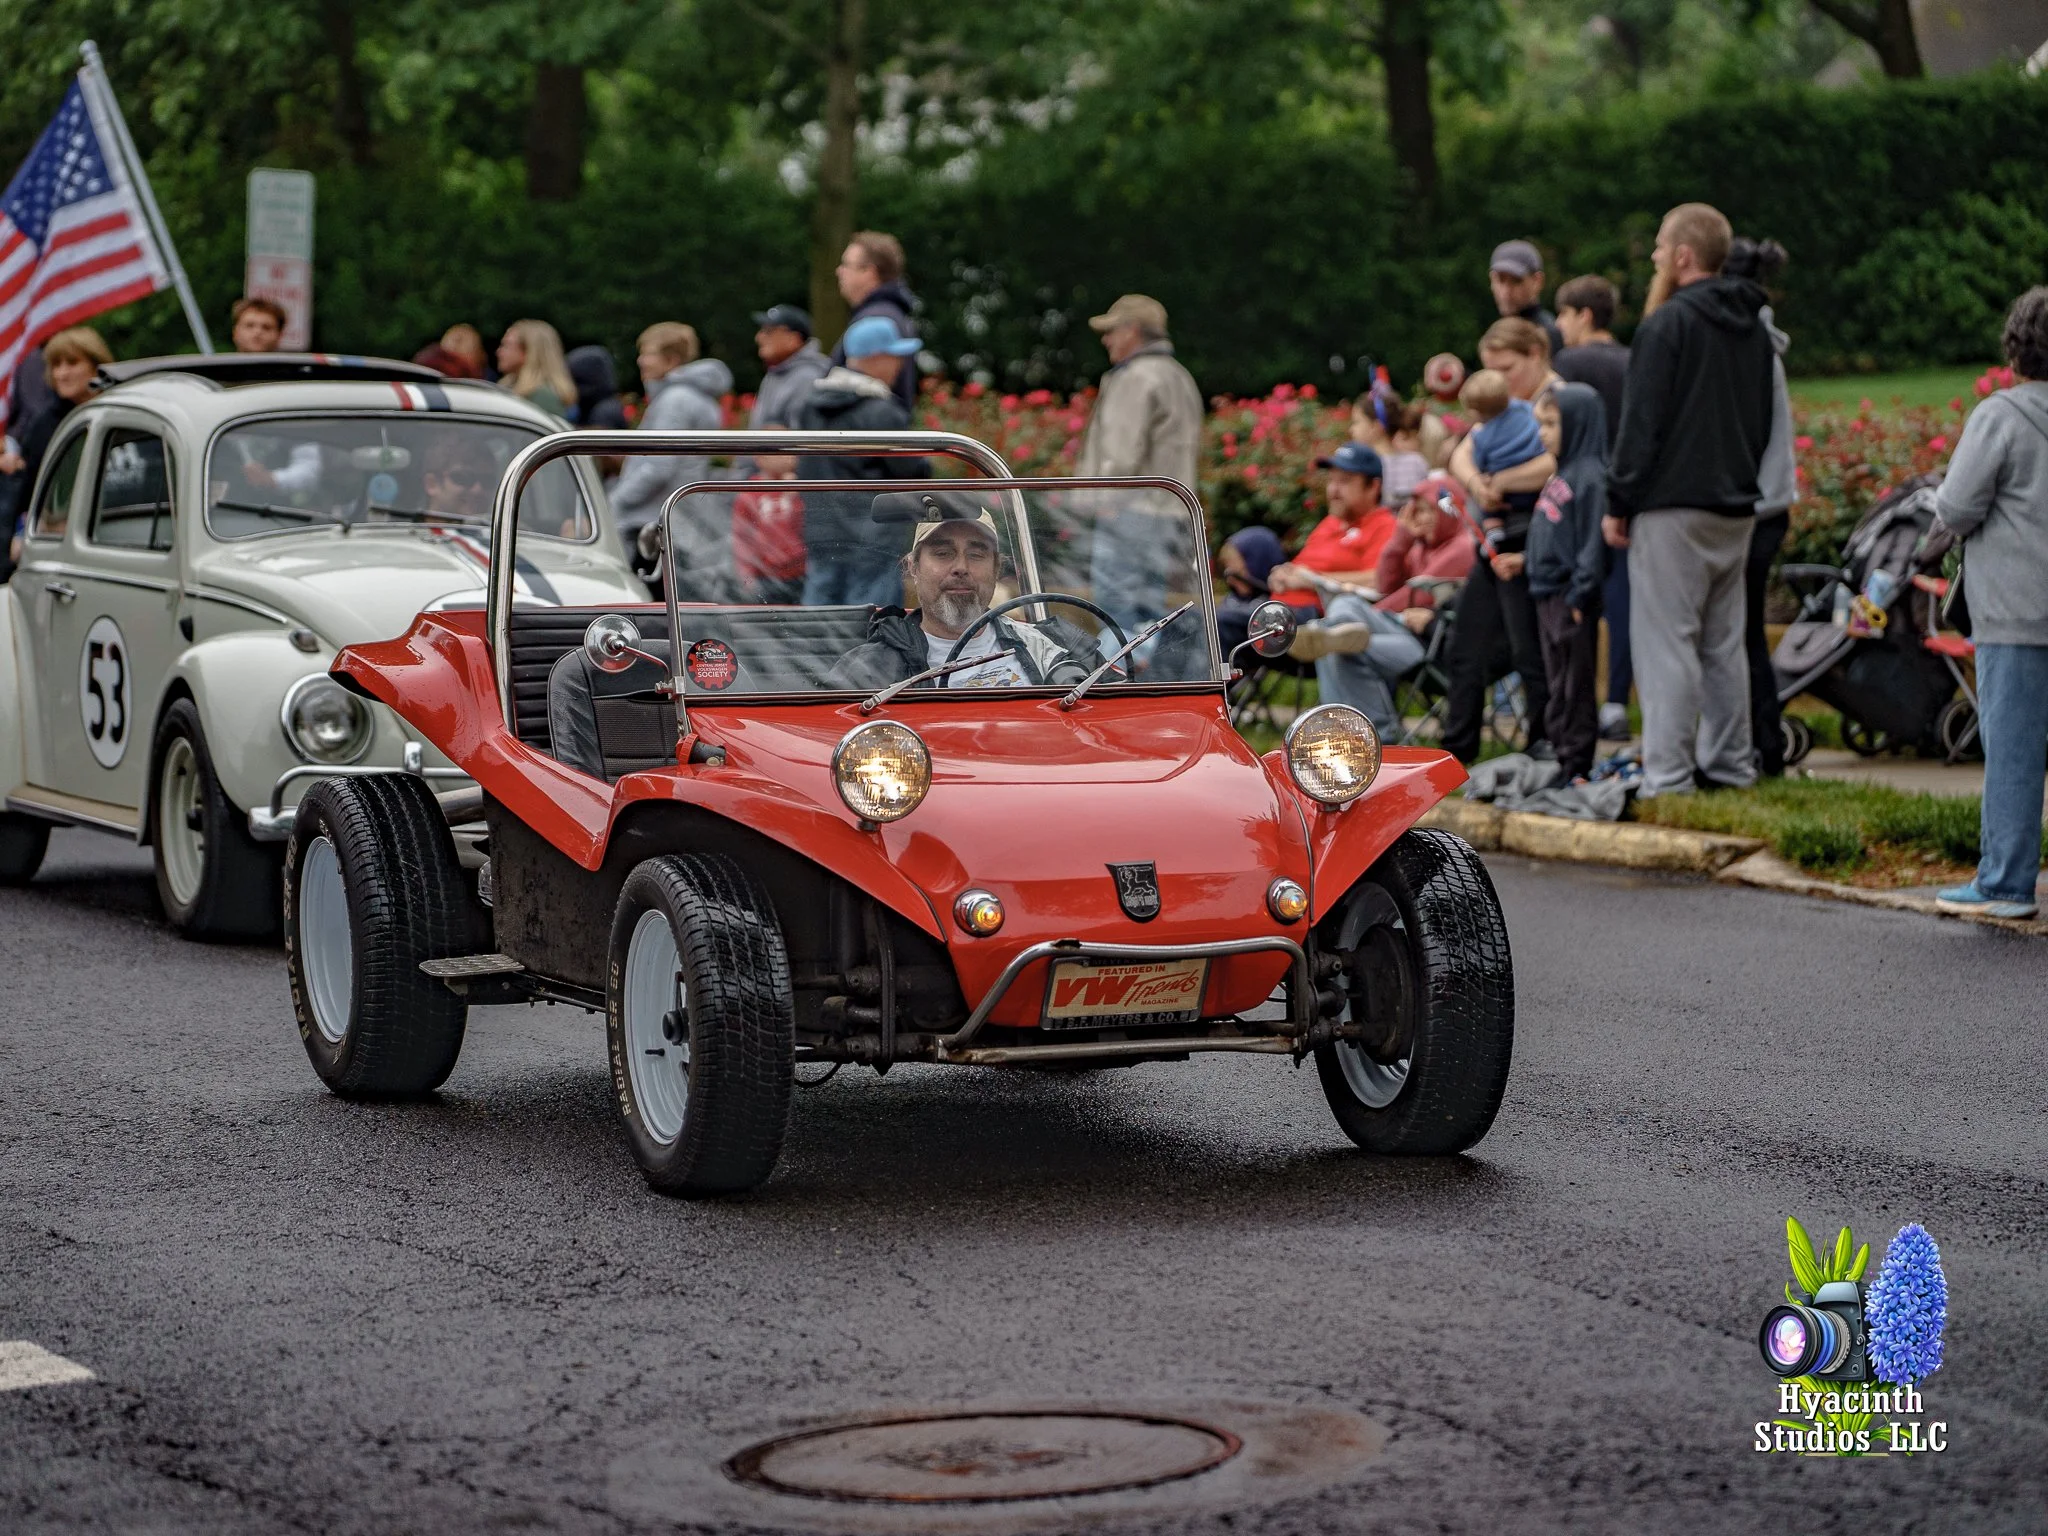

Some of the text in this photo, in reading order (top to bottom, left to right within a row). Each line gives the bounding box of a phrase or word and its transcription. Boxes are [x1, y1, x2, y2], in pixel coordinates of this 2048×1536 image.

[88, 641, 125, 744] 53
[1098, 964, 1166, 975] FEATURED IN
[1053, 969, 1199, 1007] VW Trends
[1140, 997, 1179, 1006] MAGAZINE
[609, 1000, 618, 1029] SR
[1091, 1013, 1142, 1026] MEYERS
[612, 1040, 631, 1116] RADIAL
